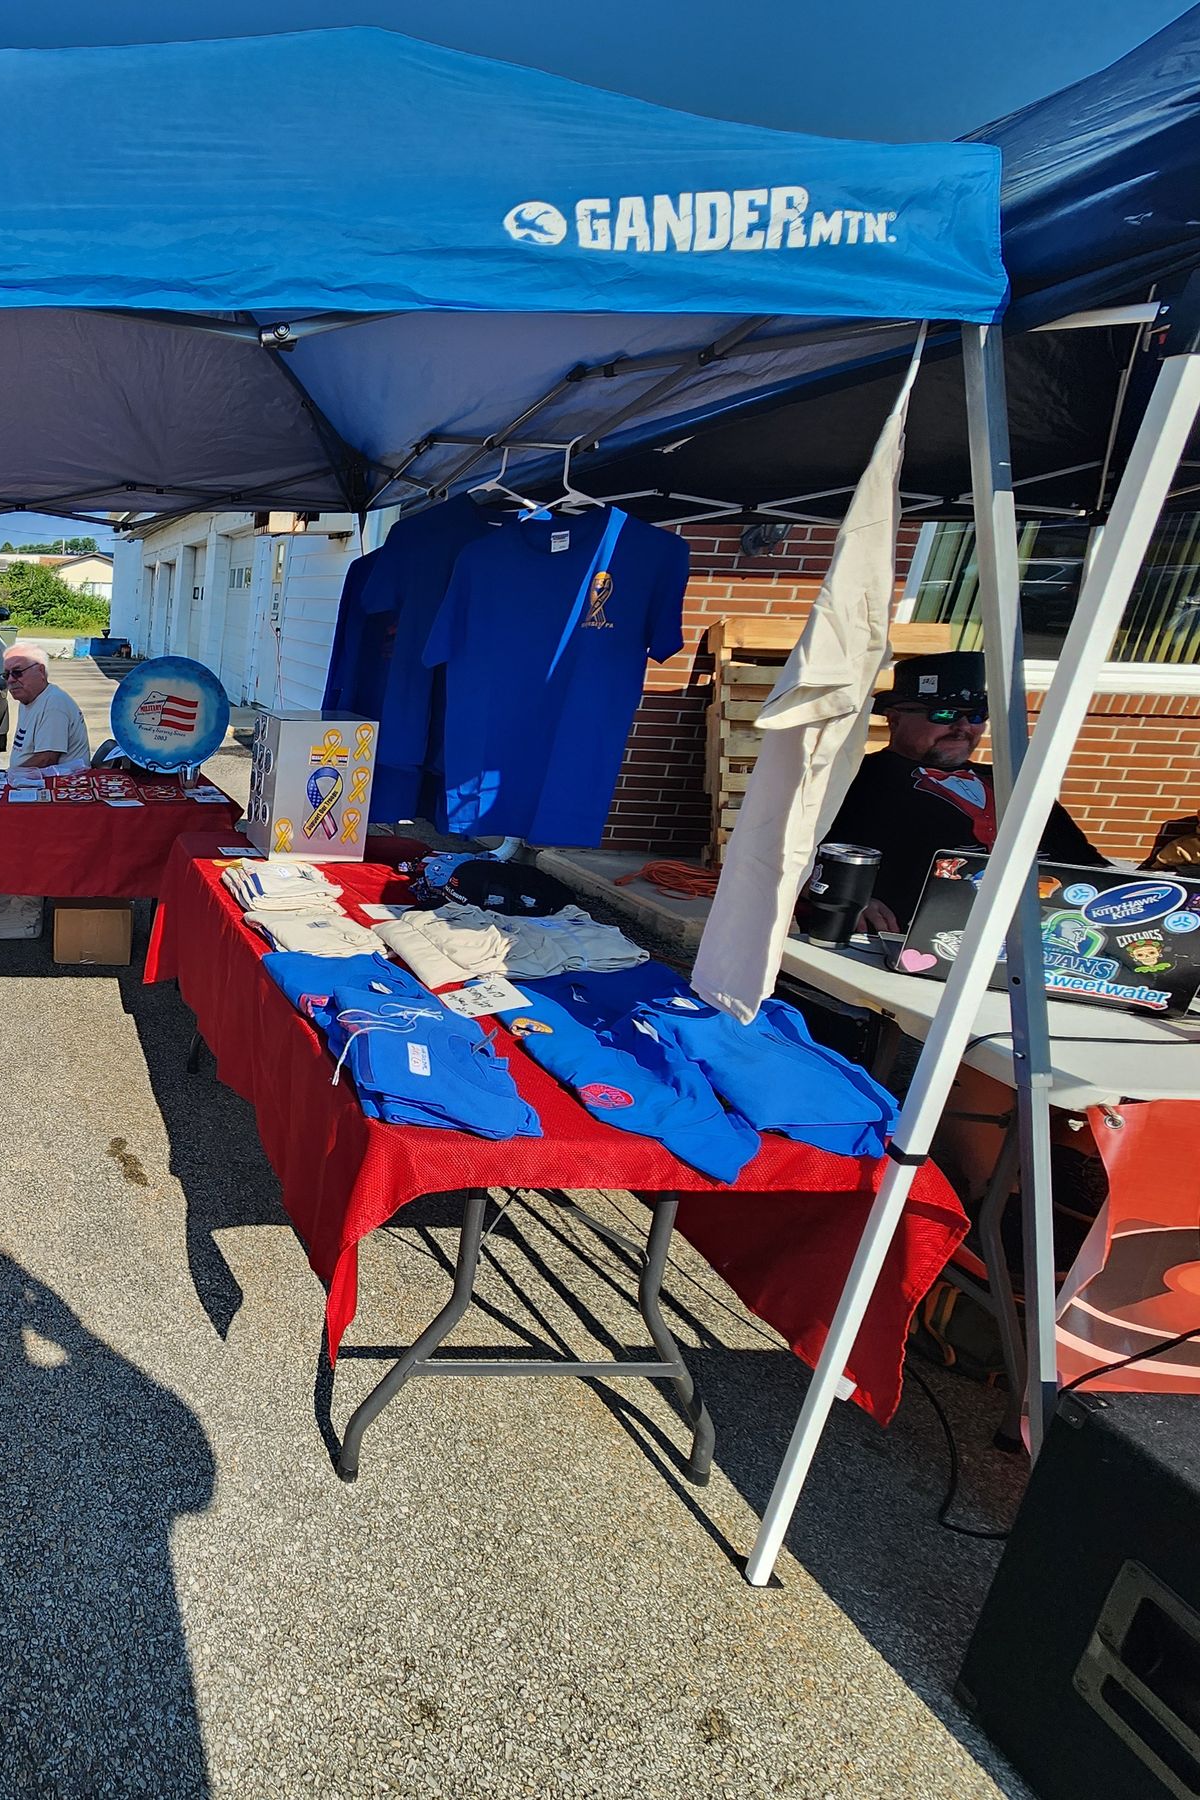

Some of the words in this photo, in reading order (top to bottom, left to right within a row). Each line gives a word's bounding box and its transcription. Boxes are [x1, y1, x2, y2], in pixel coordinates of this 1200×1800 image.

[575, 186, 809, 252] GANDER
[307, 813, 323, 831] Support
[324, 790, 339, 807] Troops
[1112, 906, 1145, 919] KITES
